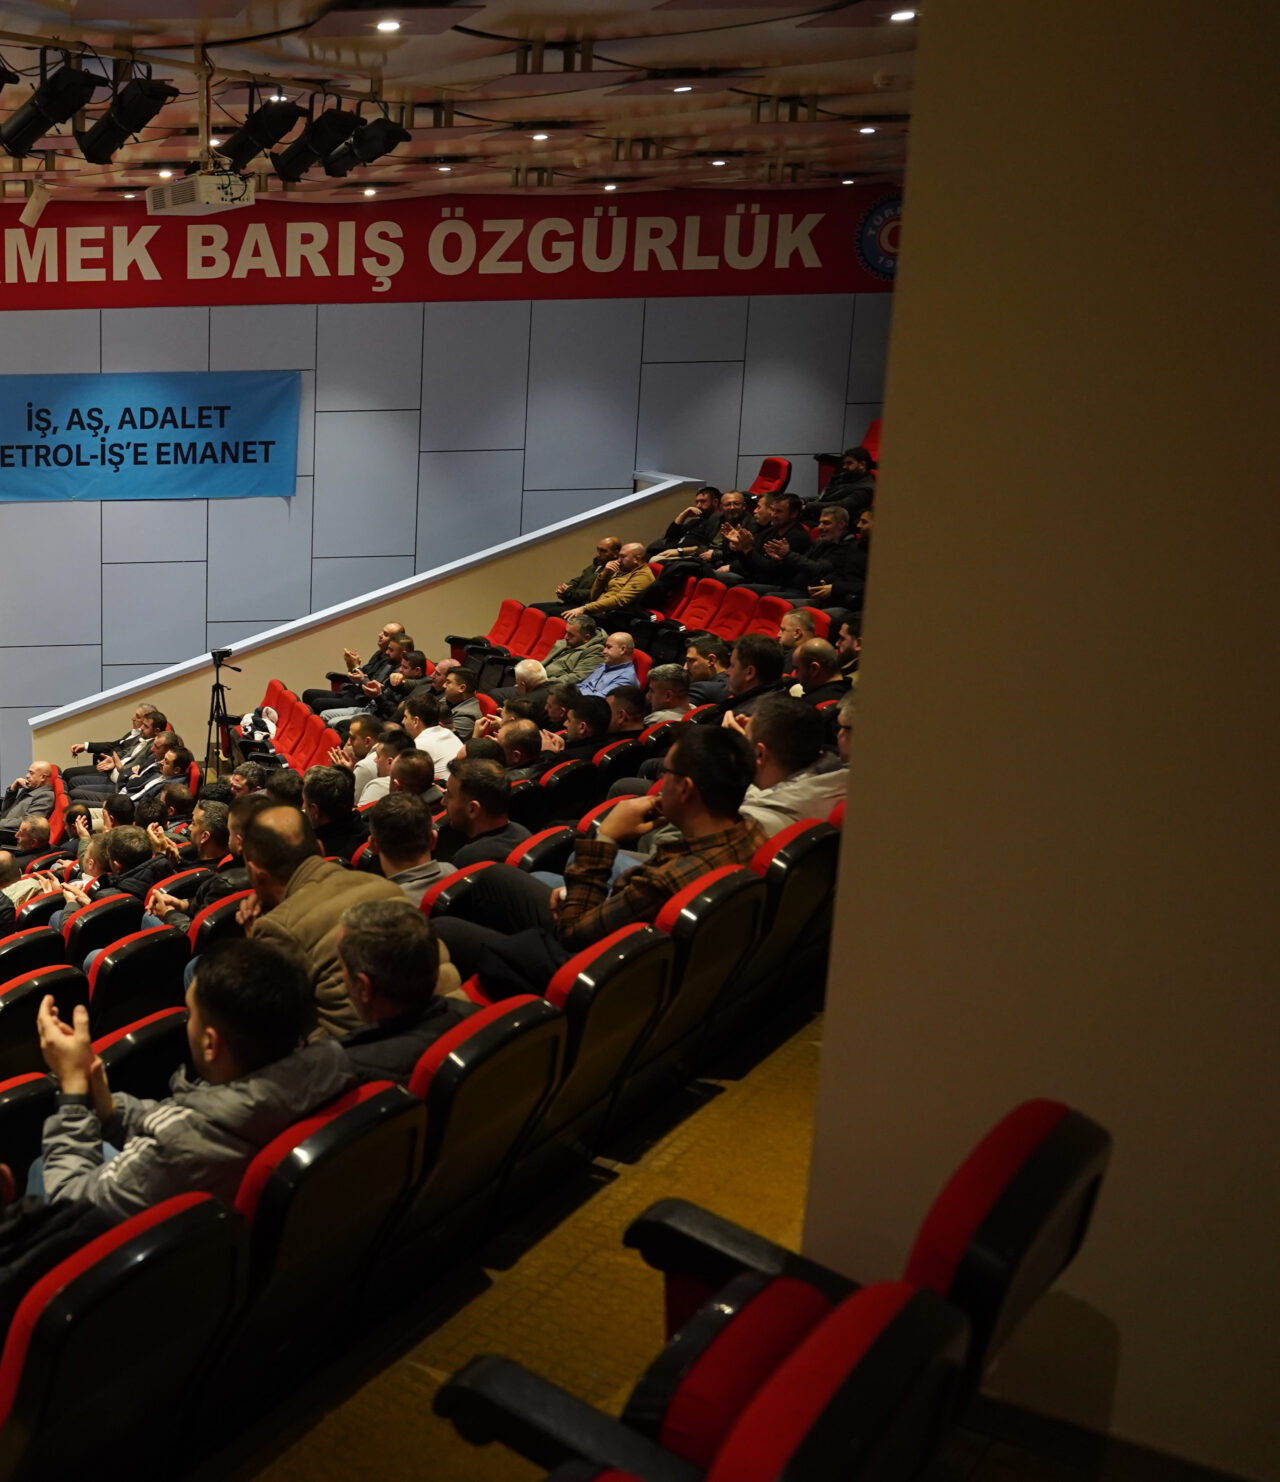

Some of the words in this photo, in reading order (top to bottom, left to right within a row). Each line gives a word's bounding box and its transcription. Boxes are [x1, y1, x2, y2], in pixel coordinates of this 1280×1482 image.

[186, 220, 405, 292] BARIŞ
[427, 203, 827, 276] ÖZGÜRLÜK
[27, 402, 58, 438] İŞ,
[66, 407, 110, 437] AŞ,
[118, 405, 231, 430] ADALET
[156, 441, 276, 465] EMANET
